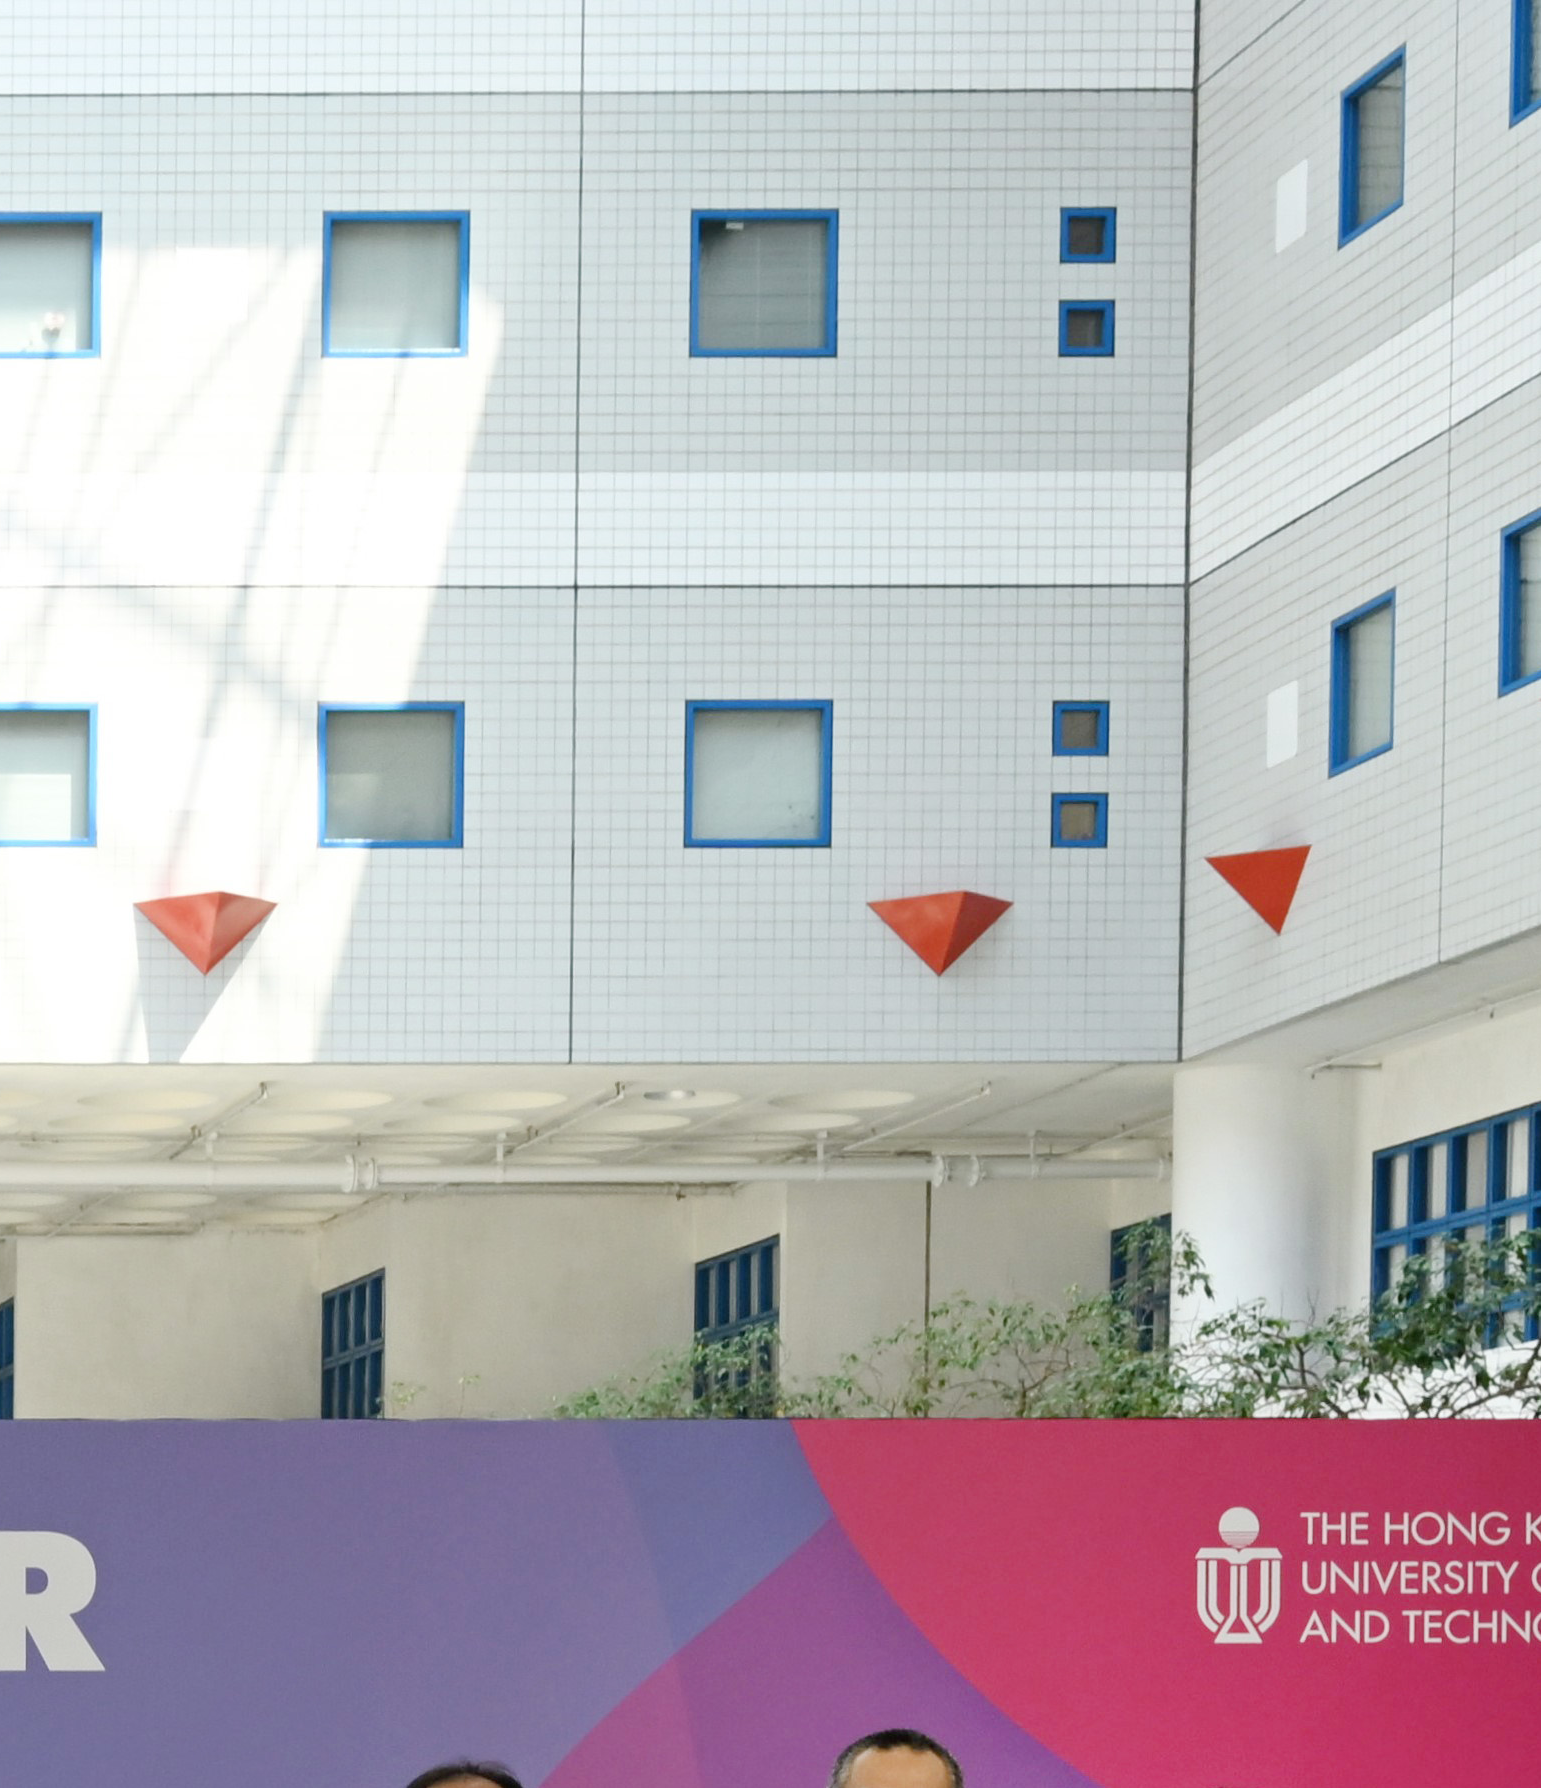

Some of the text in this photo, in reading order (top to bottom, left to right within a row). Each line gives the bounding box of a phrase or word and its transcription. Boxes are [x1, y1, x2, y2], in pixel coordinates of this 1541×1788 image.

[1300, 1512, 1369, 1545] THE
[1383, 1511, 1511, 1546] HONG
[1301, 1560, 1520, 1595] UNIVERSITY
[1299, 1609, 1390, 1643] AND
